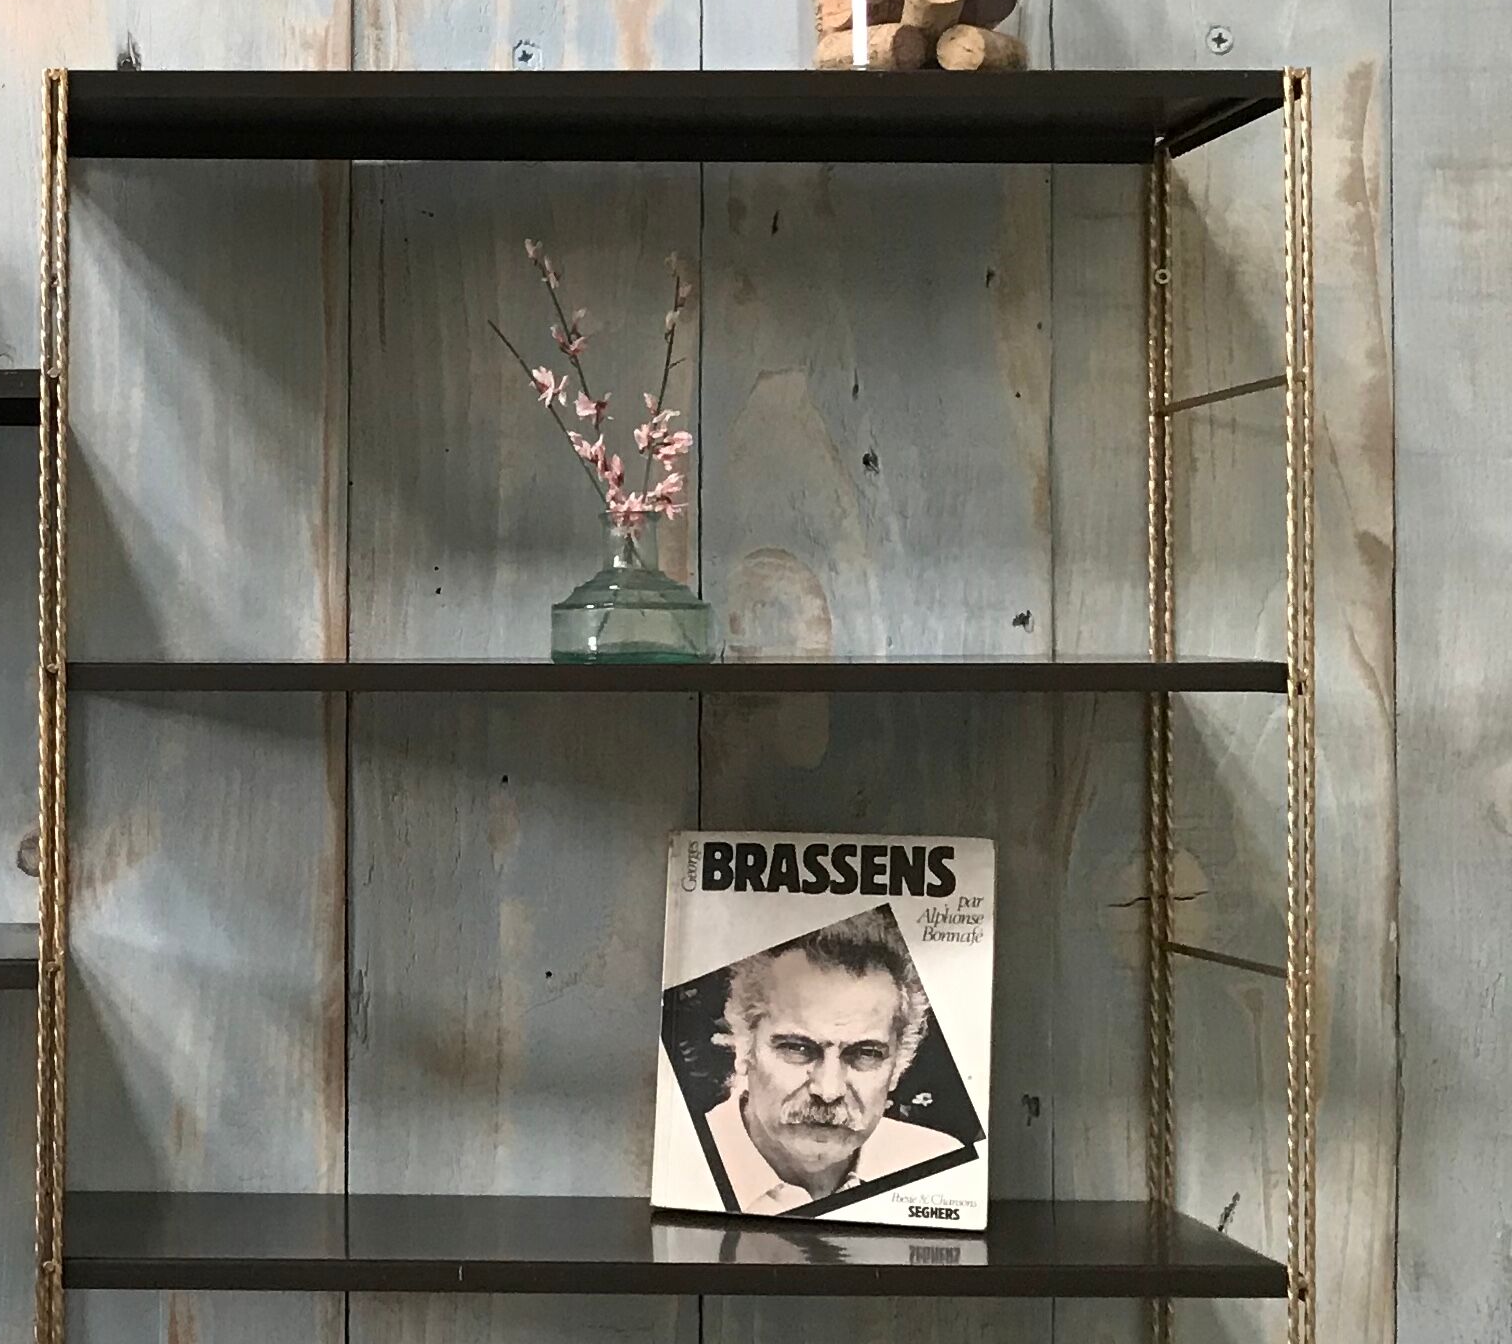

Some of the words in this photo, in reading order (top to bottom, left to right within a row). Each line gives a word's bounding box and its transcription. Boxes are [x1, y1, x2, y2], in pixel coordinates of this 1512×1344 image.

[681, 840, 701, 892] Georges
[702, 841, 956, 898] BRASSENS
[957, 895, 984, 912] par
[916, 906, 984, 928] Alphonse
[908, 1205, 960, 1220] SEGHERS
